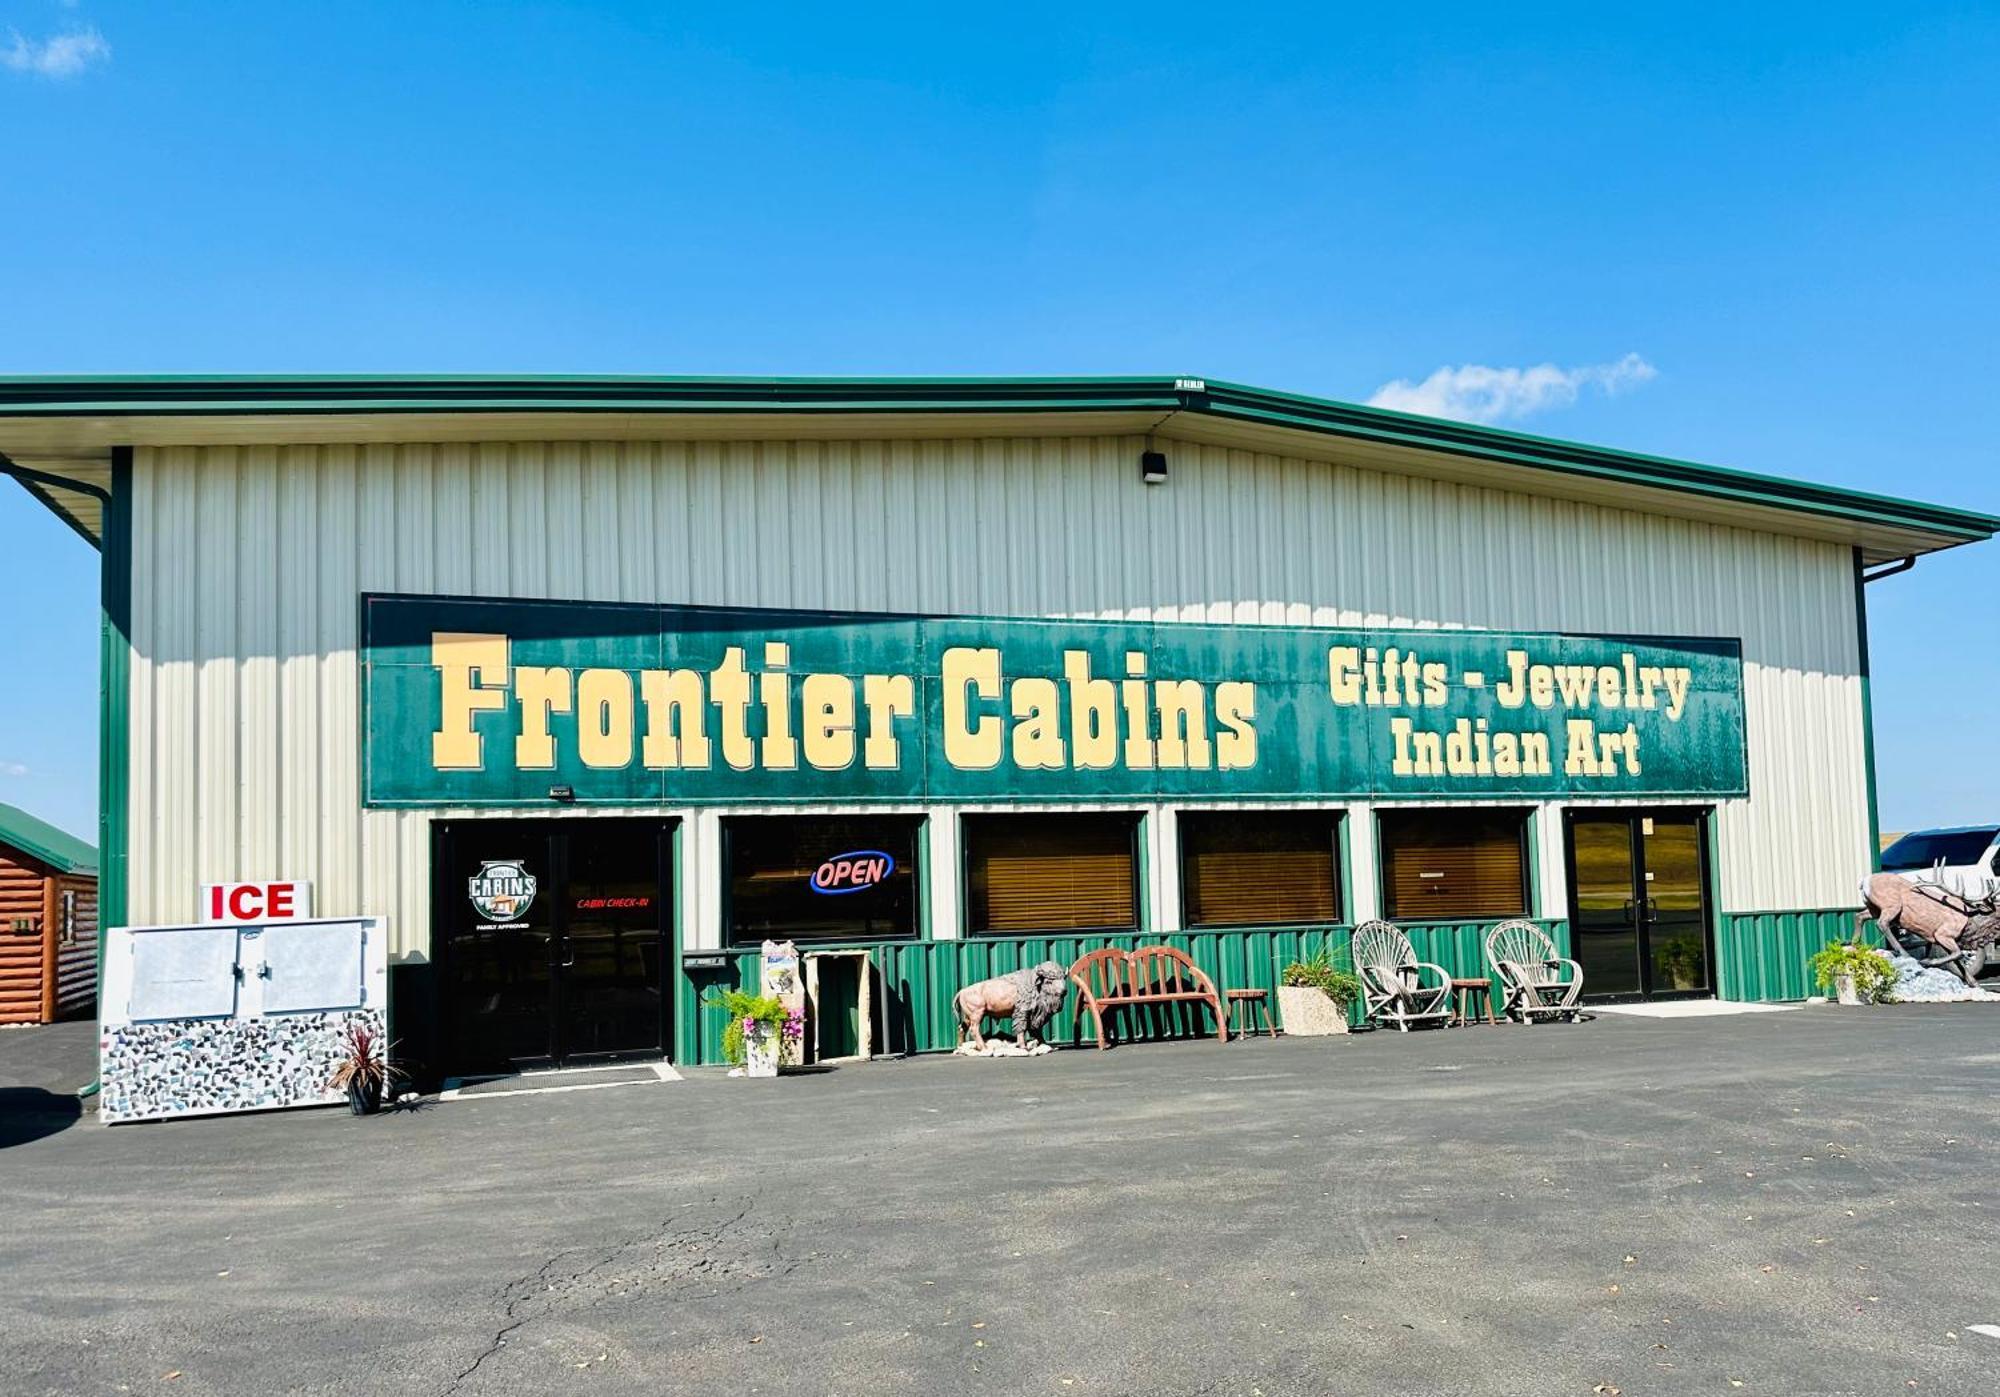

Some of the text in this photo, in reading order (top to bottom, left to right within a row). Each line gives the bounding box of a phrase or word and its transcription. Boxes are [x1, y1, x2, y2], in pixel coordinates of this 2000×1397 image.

[432, 631, 1257, 771] Frontier Cabins
[1329, 646, 1691, 721] Gifts - Jewelry
[1391, 717, 1642, 777] Indian Art
[471, 878, 535, 897] CABINS
[815, 858, 885, 888] OPEN
[211, 883, 295, 921] ICE
[576, 897, 649, 909] CABIN CHECK-IN
